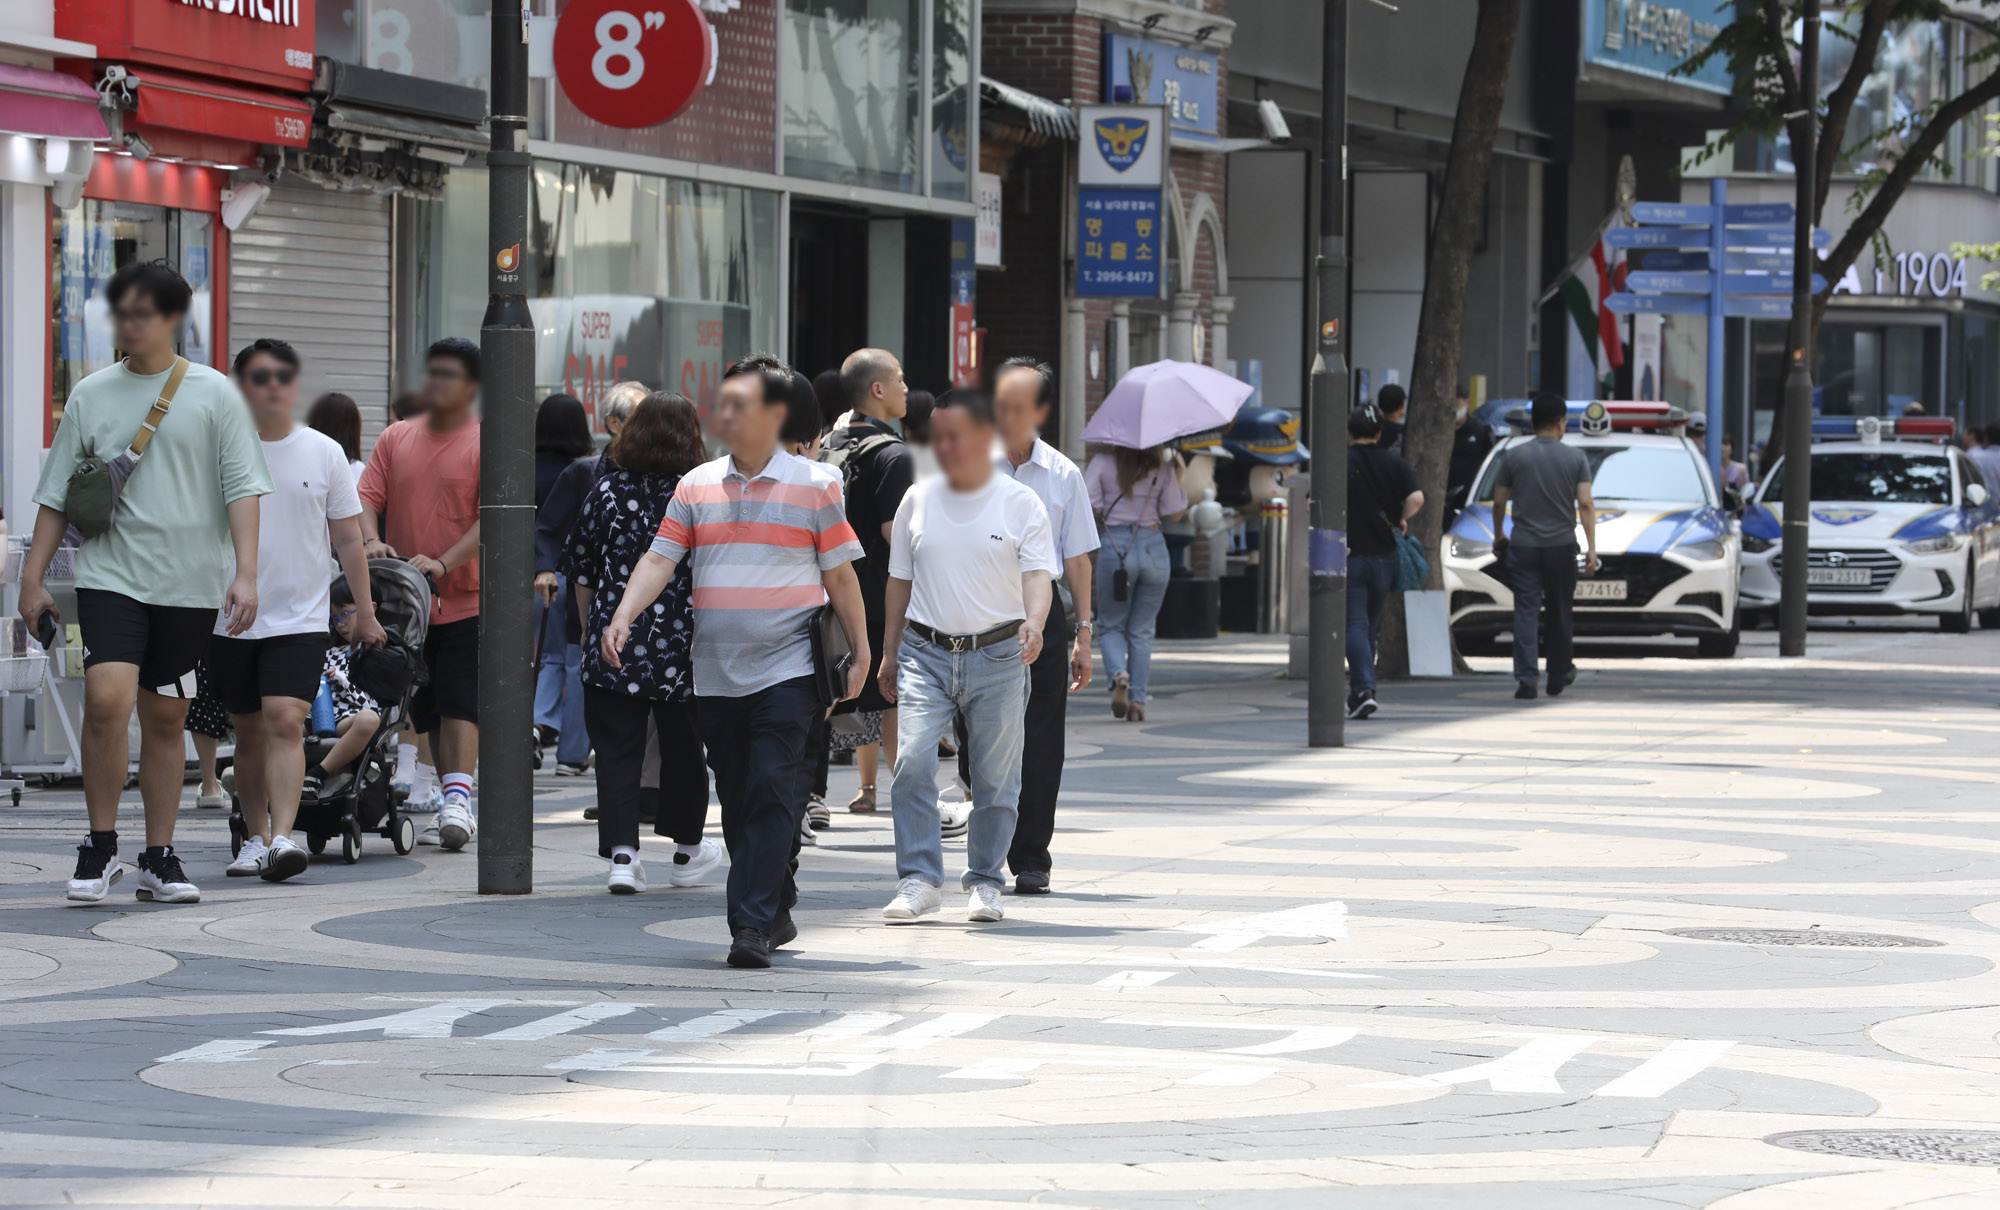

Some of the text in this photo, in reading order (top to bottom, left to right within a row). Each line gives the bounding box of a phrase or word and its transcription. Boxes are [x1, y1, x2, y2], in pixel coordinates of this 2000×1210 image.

[1085, 200, 1102, 210] 서울
[1096, 270, 1154, 283] 2096-8473
[1895, 252, 1967, 297] 1904
[582, 312, 611, 340] SUPER
[1586, 584, 1621, 596] 7416
